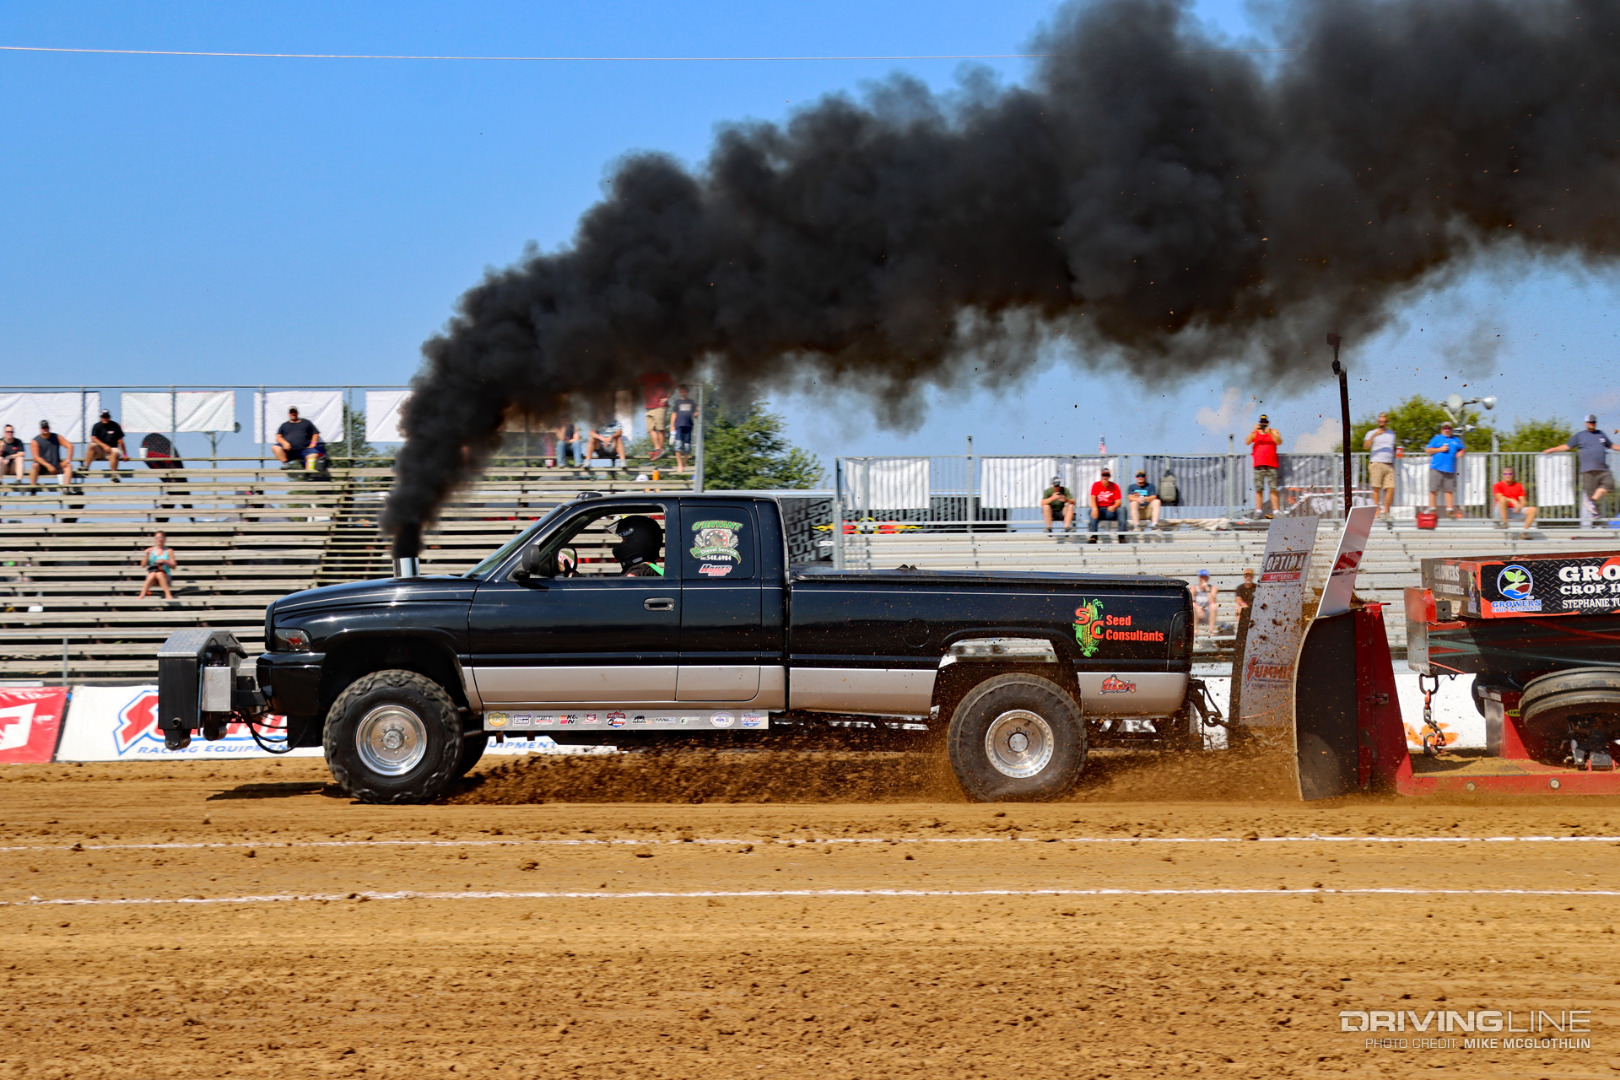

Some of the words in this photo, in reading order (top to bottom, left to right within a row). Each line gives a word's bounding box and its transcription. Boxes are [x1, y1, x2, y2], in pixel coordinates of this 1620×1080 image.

[691, 520, 743, 531] O'BRYANT
[1266, 554, 1306, 571] OPTIMA
[1559, 583, 1606, 595] CROP
[1491, 600, 1541, 608] GROWERS
[1562, 598, 1610, 609] STEPHANIE
[1106, 614, 1132, 626] Seed
[1106, 629, 1164, 641] Consultants
[204, 744, 290, 753] EQUIPMEN
[488, 741, 557, 749] UIPMENT
